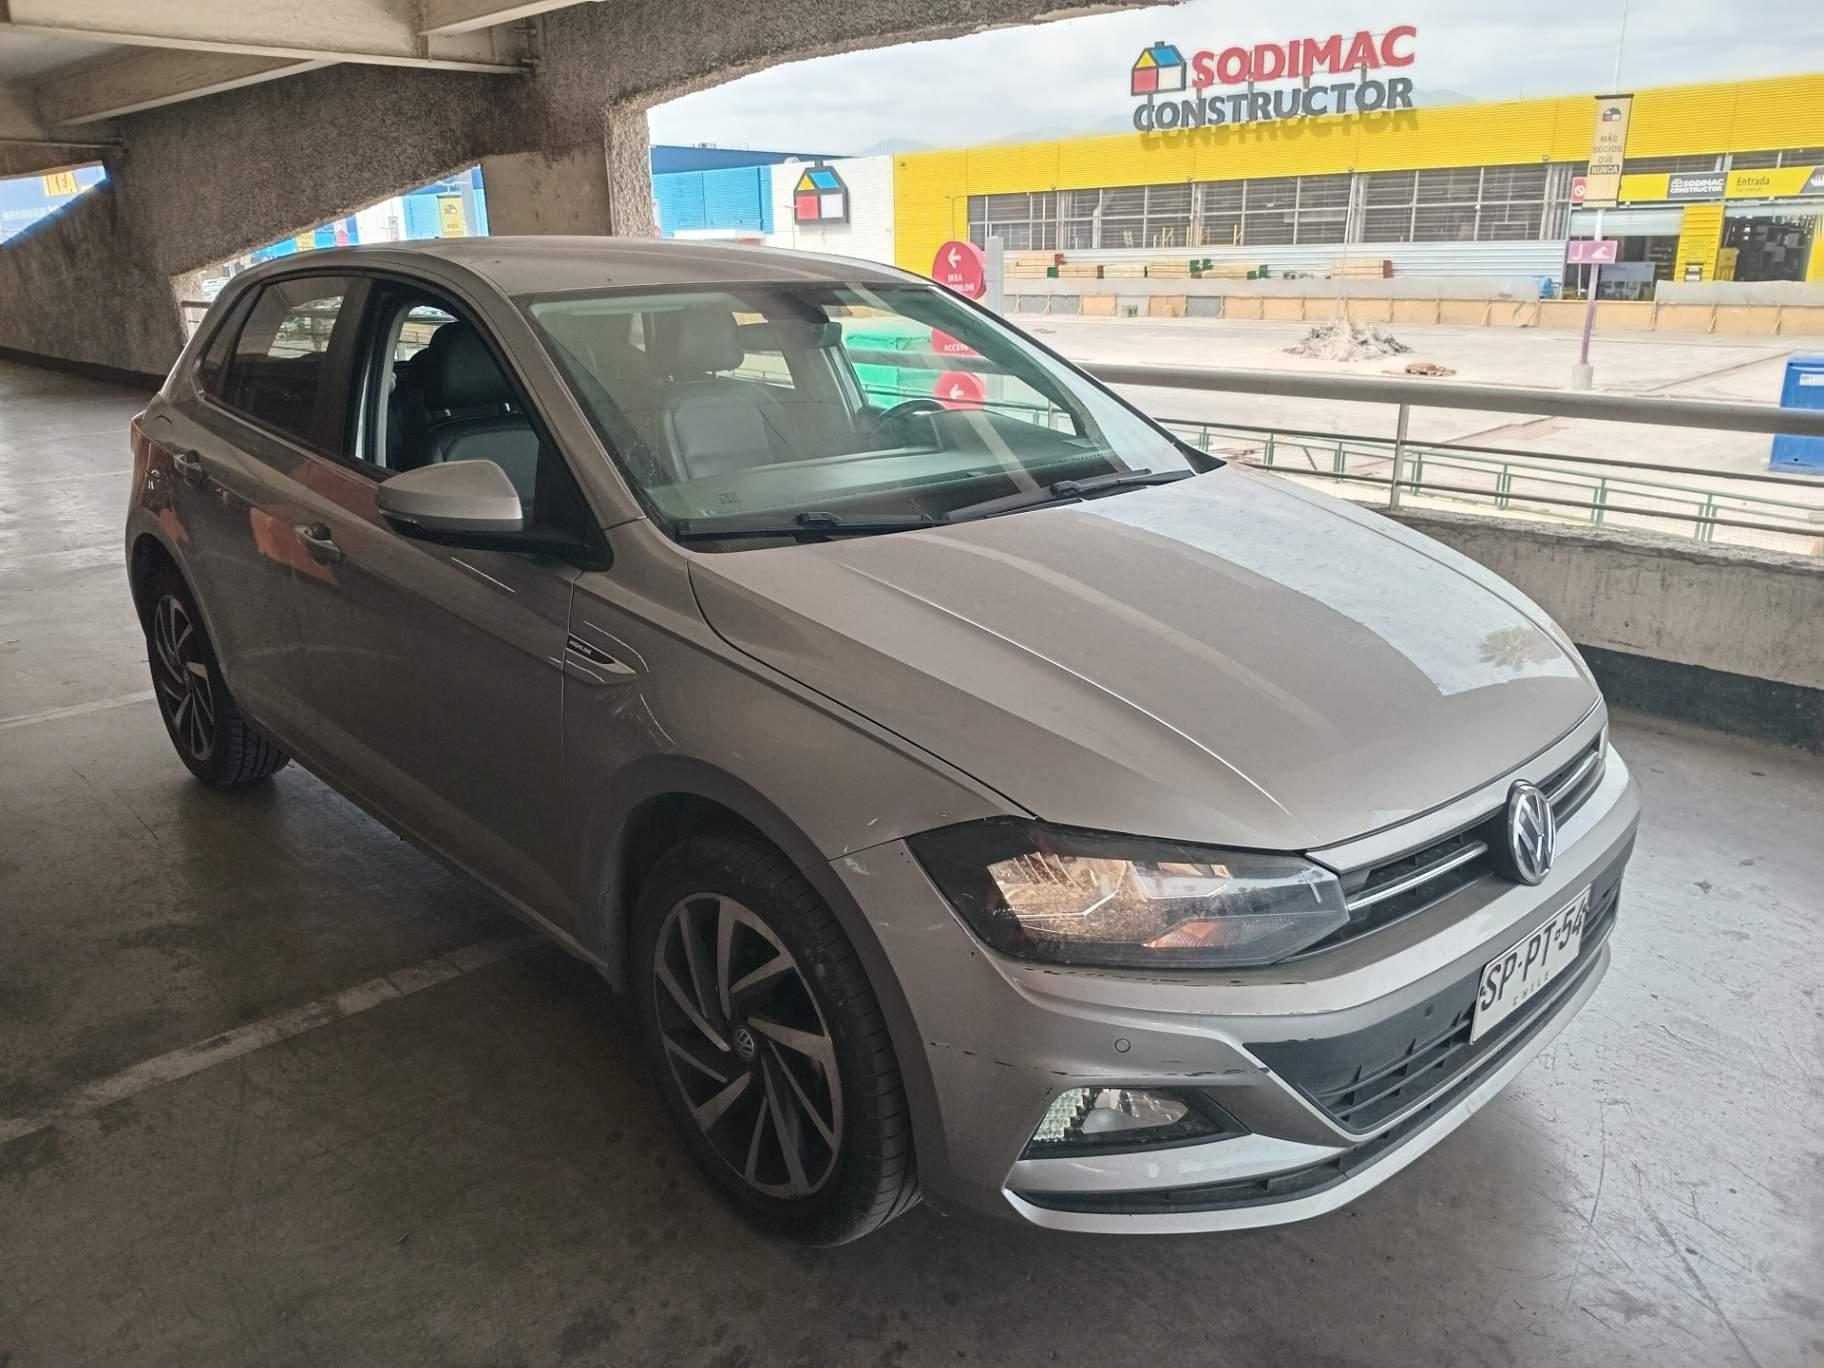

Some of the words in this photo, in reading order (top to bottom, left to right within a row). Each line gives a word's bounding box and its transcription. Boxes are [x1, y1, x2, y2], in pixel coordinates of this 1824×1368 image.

[1192, 25, 1417, 88] SODIMAC
[1133, 77, 1413, 131] CONSTRUCTOR
[1684, 178, 1724, 188] SODIMAC
[1736, 176, 1770, 186] Entrada
[1670, 186, 1723, 194] CONSTRUCTOR
[947, 274, 963, 282] IKEA
